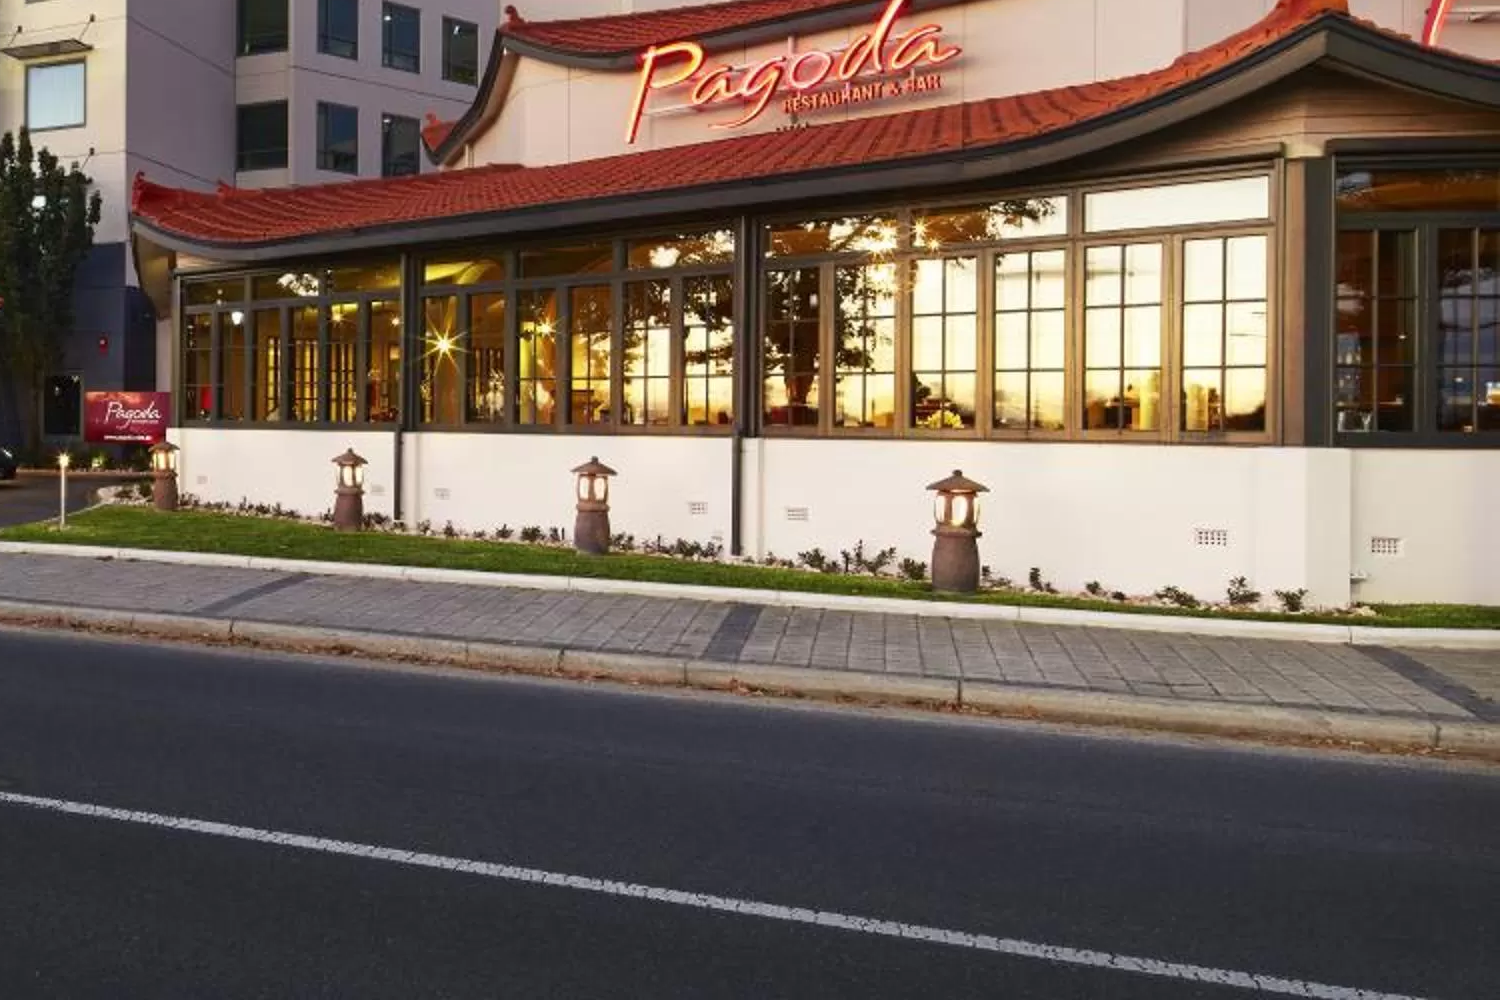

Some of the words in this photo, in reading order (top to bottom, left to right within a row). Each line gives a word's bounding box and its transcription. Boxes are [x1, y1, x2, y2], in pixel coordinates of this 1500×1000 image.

[784, 82, 884, 113] RESTAURANT
[903, 72, 944, 95] BAR
[104, 400, 162, 430] Pagoda
